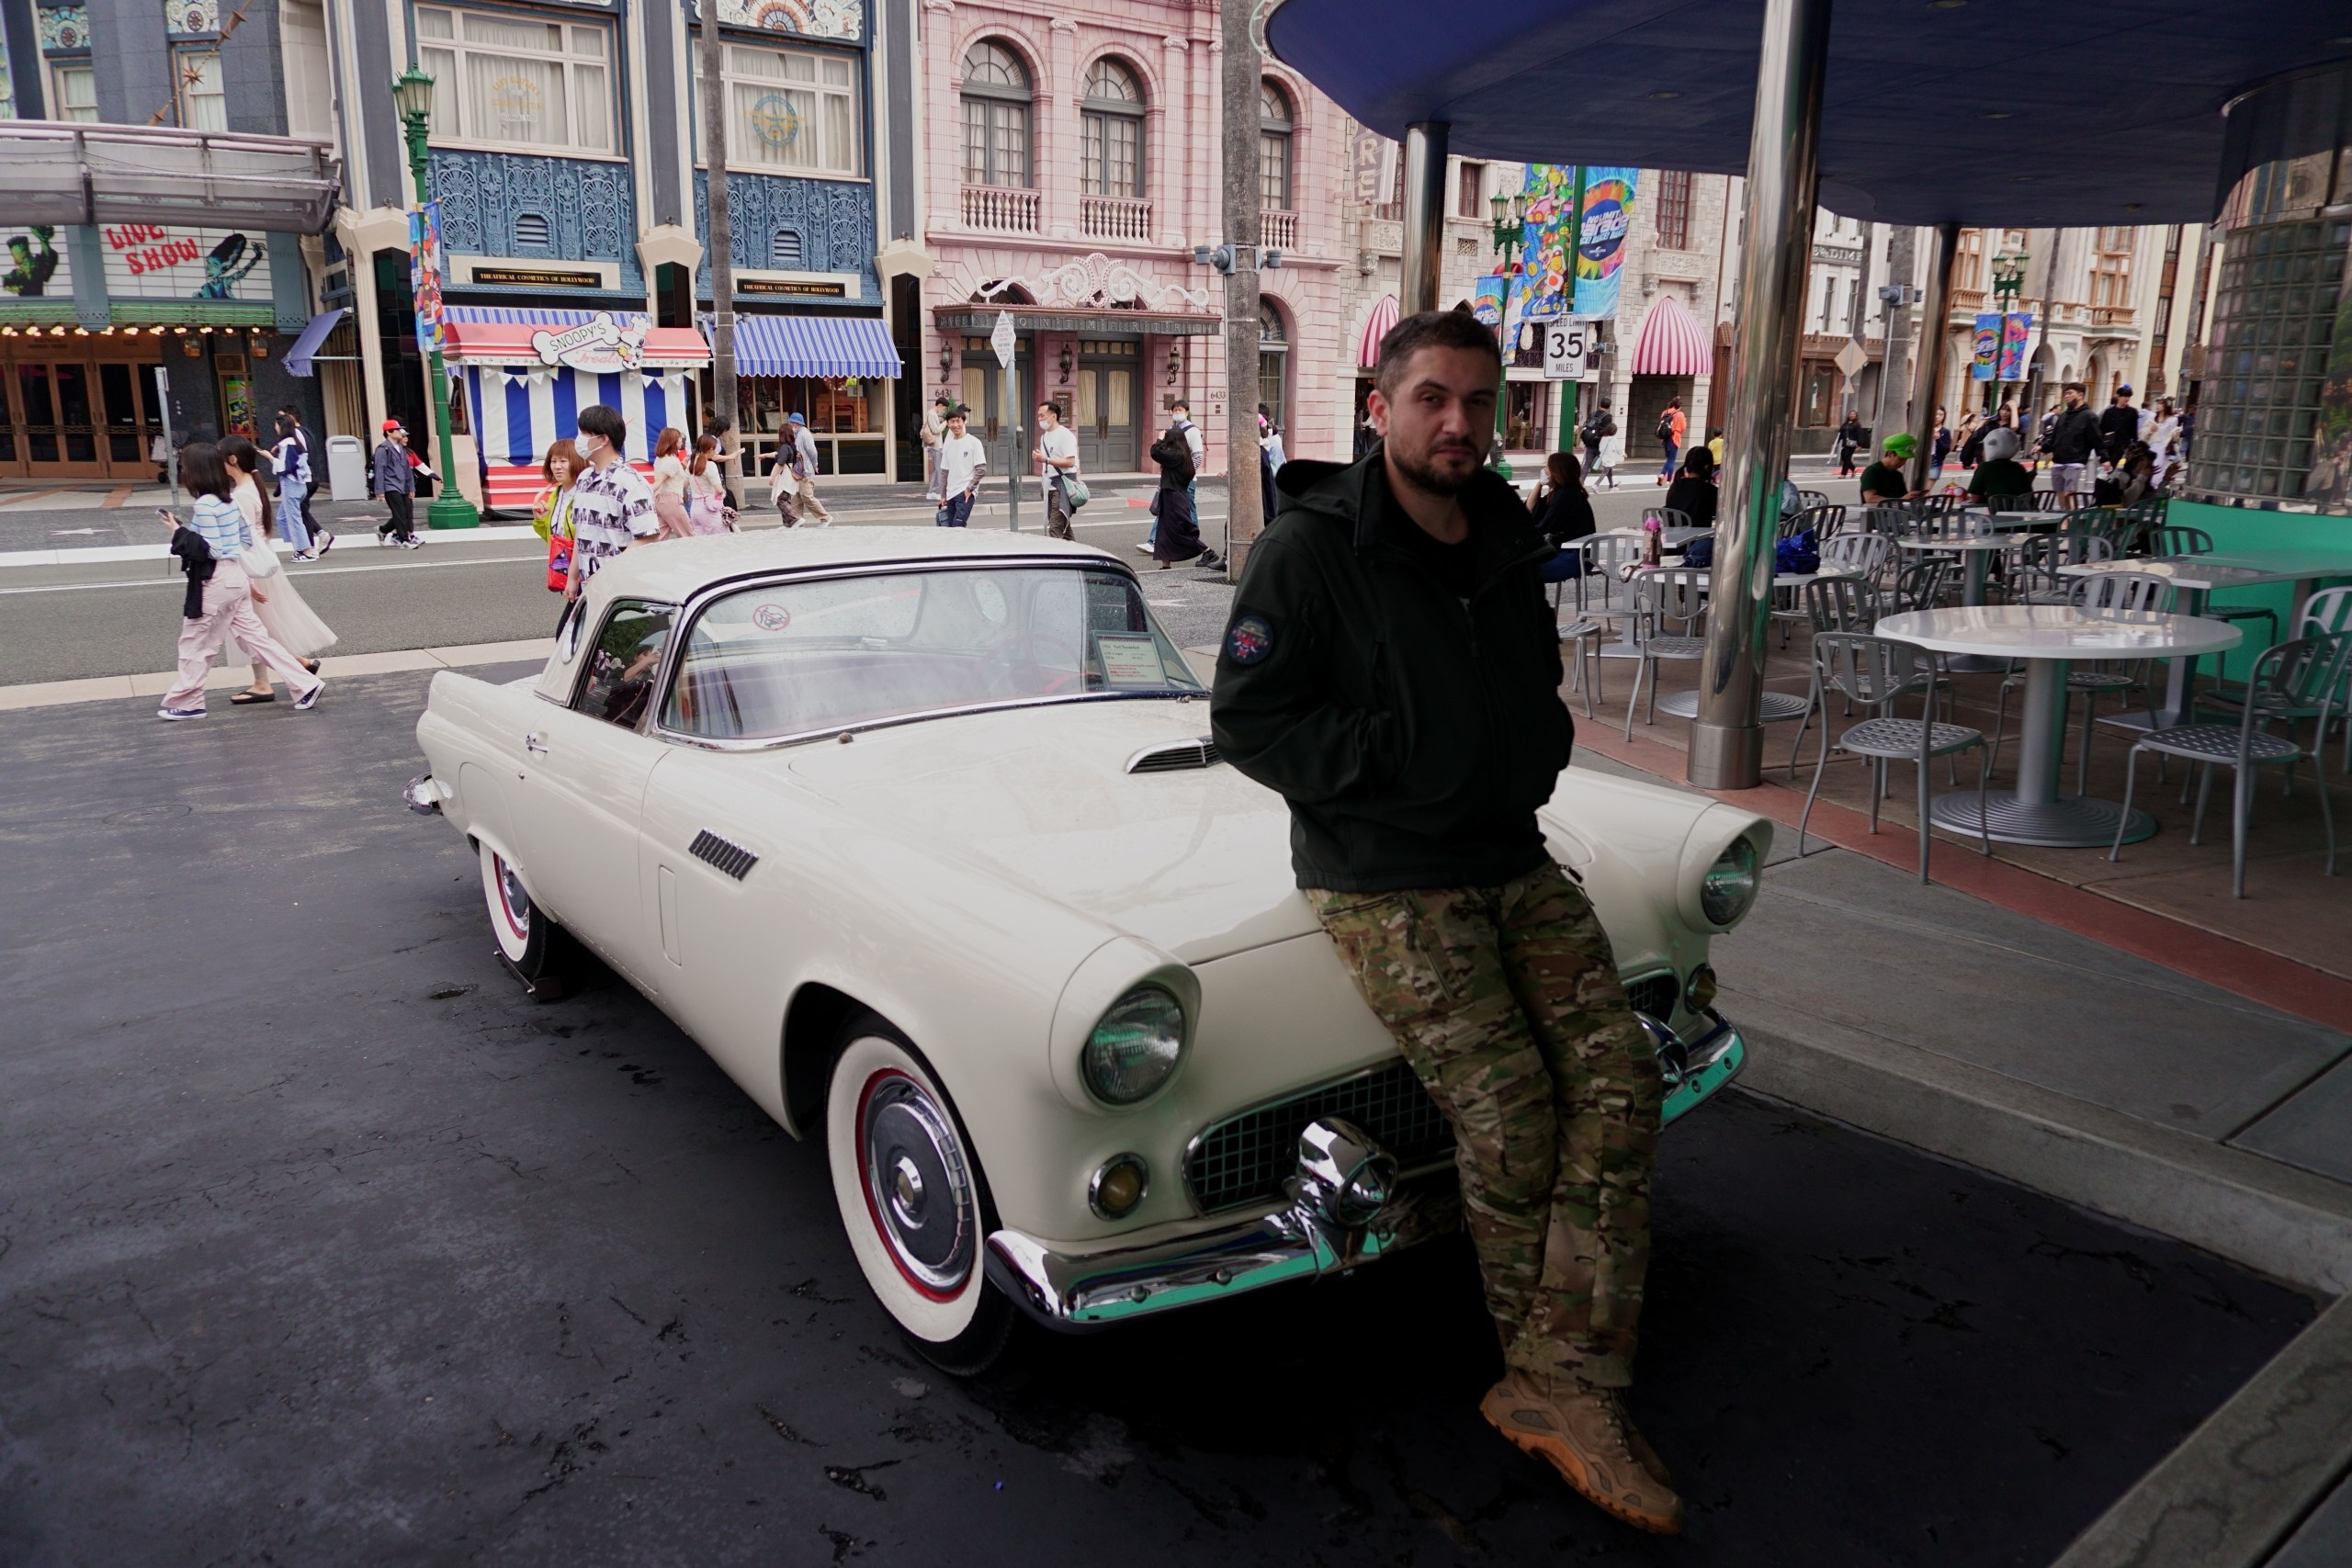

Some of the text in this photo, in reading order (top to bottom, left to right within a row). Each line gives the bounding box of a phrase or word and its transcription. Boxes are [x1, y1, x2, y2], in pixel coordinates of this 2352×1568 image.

[106, 223, 164, 250] LIVE
[125, 238, 199, 275] SHOW
[1019, 317, 1201, 333] ONTMARTRE
[549, 322, 606, 352] SNOOPY'S
[1549, 332, 1583, 359] 35
[575, 350, 620, 365] Treats
[1555, 363, 1574, 373] MILES
[1210, 390, 1227, 400] 6433
